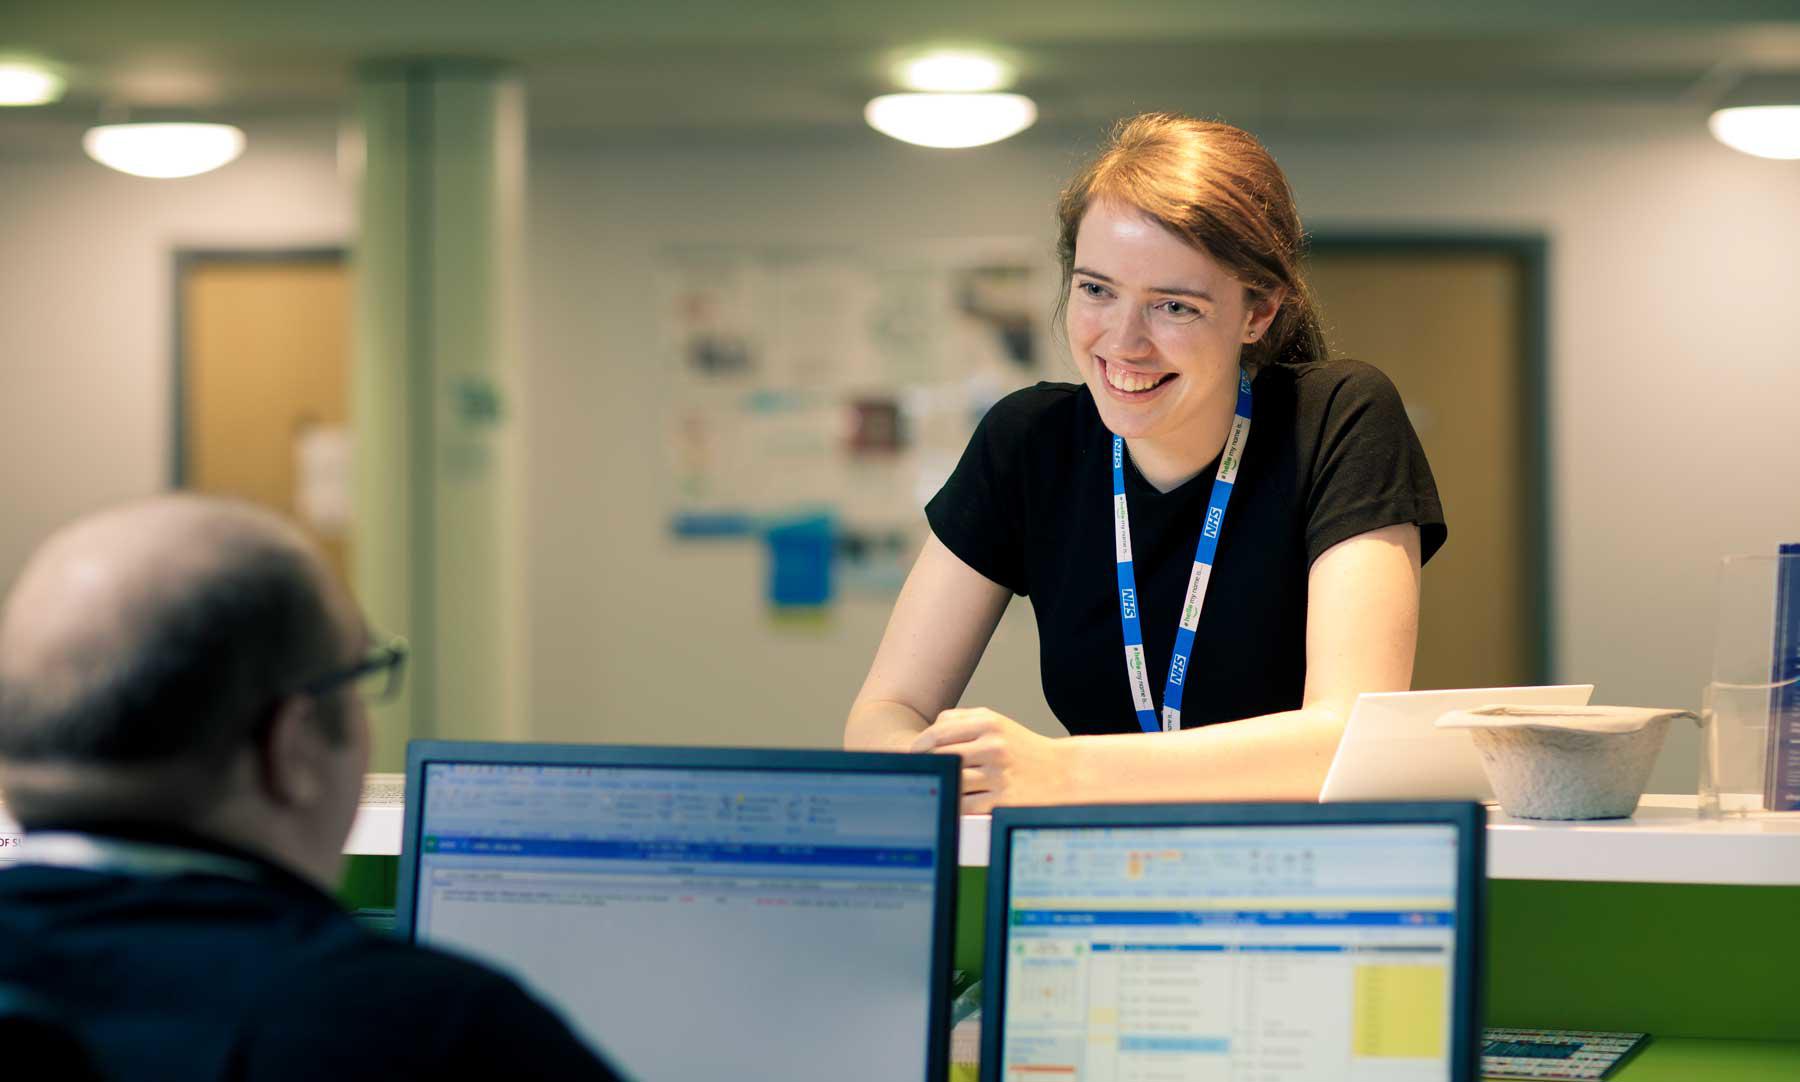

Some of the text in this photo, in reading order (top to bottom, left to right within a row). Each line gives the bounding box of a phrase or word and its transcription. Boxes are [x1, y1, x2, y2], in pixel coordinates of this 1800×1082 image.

[1228, 446, 1236, 456] my
[1205, 508, 1221, 538] NHS
[1122, 590, 1135, 618] NHS
[1190, 593, 1196, 604] my
[1136, 670, 1142, 680] my
[1170, 656, 1185, 684] NHS
